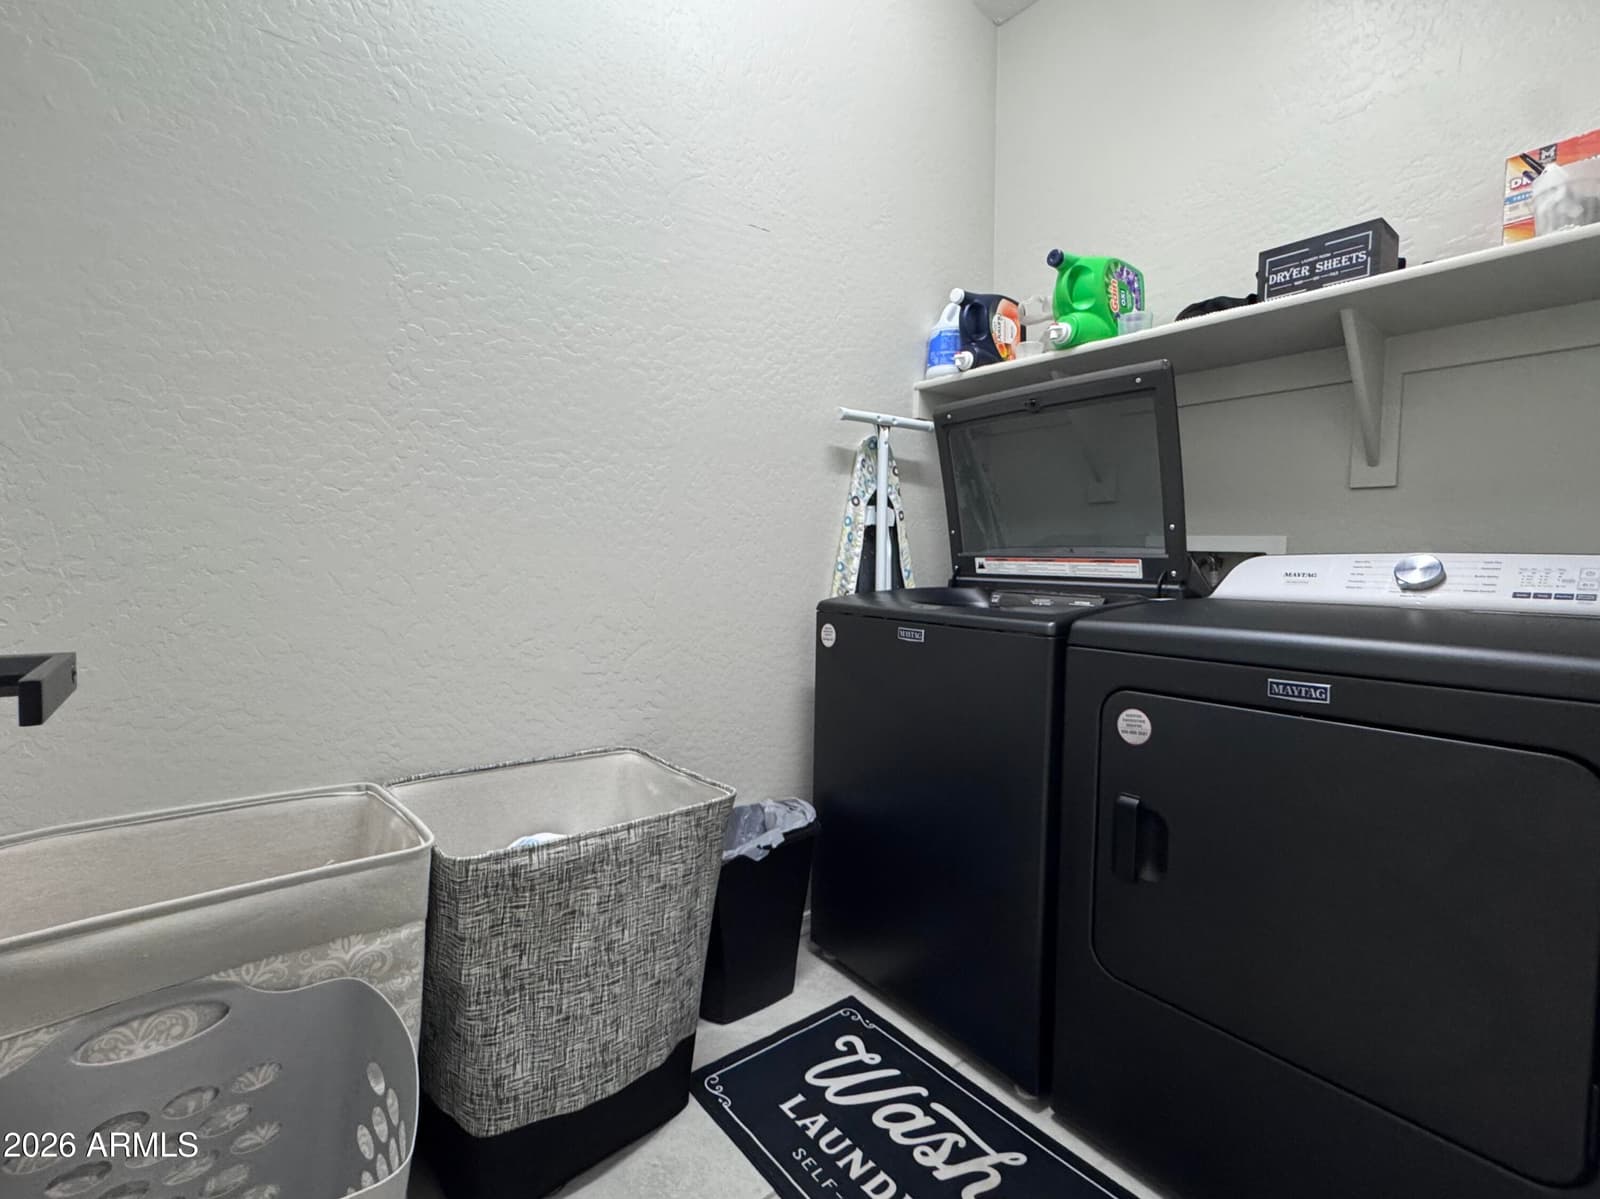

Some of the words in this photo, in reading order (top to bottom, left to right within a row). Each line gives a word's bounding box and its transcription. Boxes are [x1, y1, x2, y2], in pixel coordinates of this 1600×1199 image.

[1268, 265, 1311, 286] DRYER
[1315, 250, 1367, 273] SHEETS
[1109, 278, 1120, 313] Gain
[1270, 683, 1327, 700] MAYTAG
[803, 1034, 1027, 1199] Wash
[779, 1093, 916, 1199] LAUND
